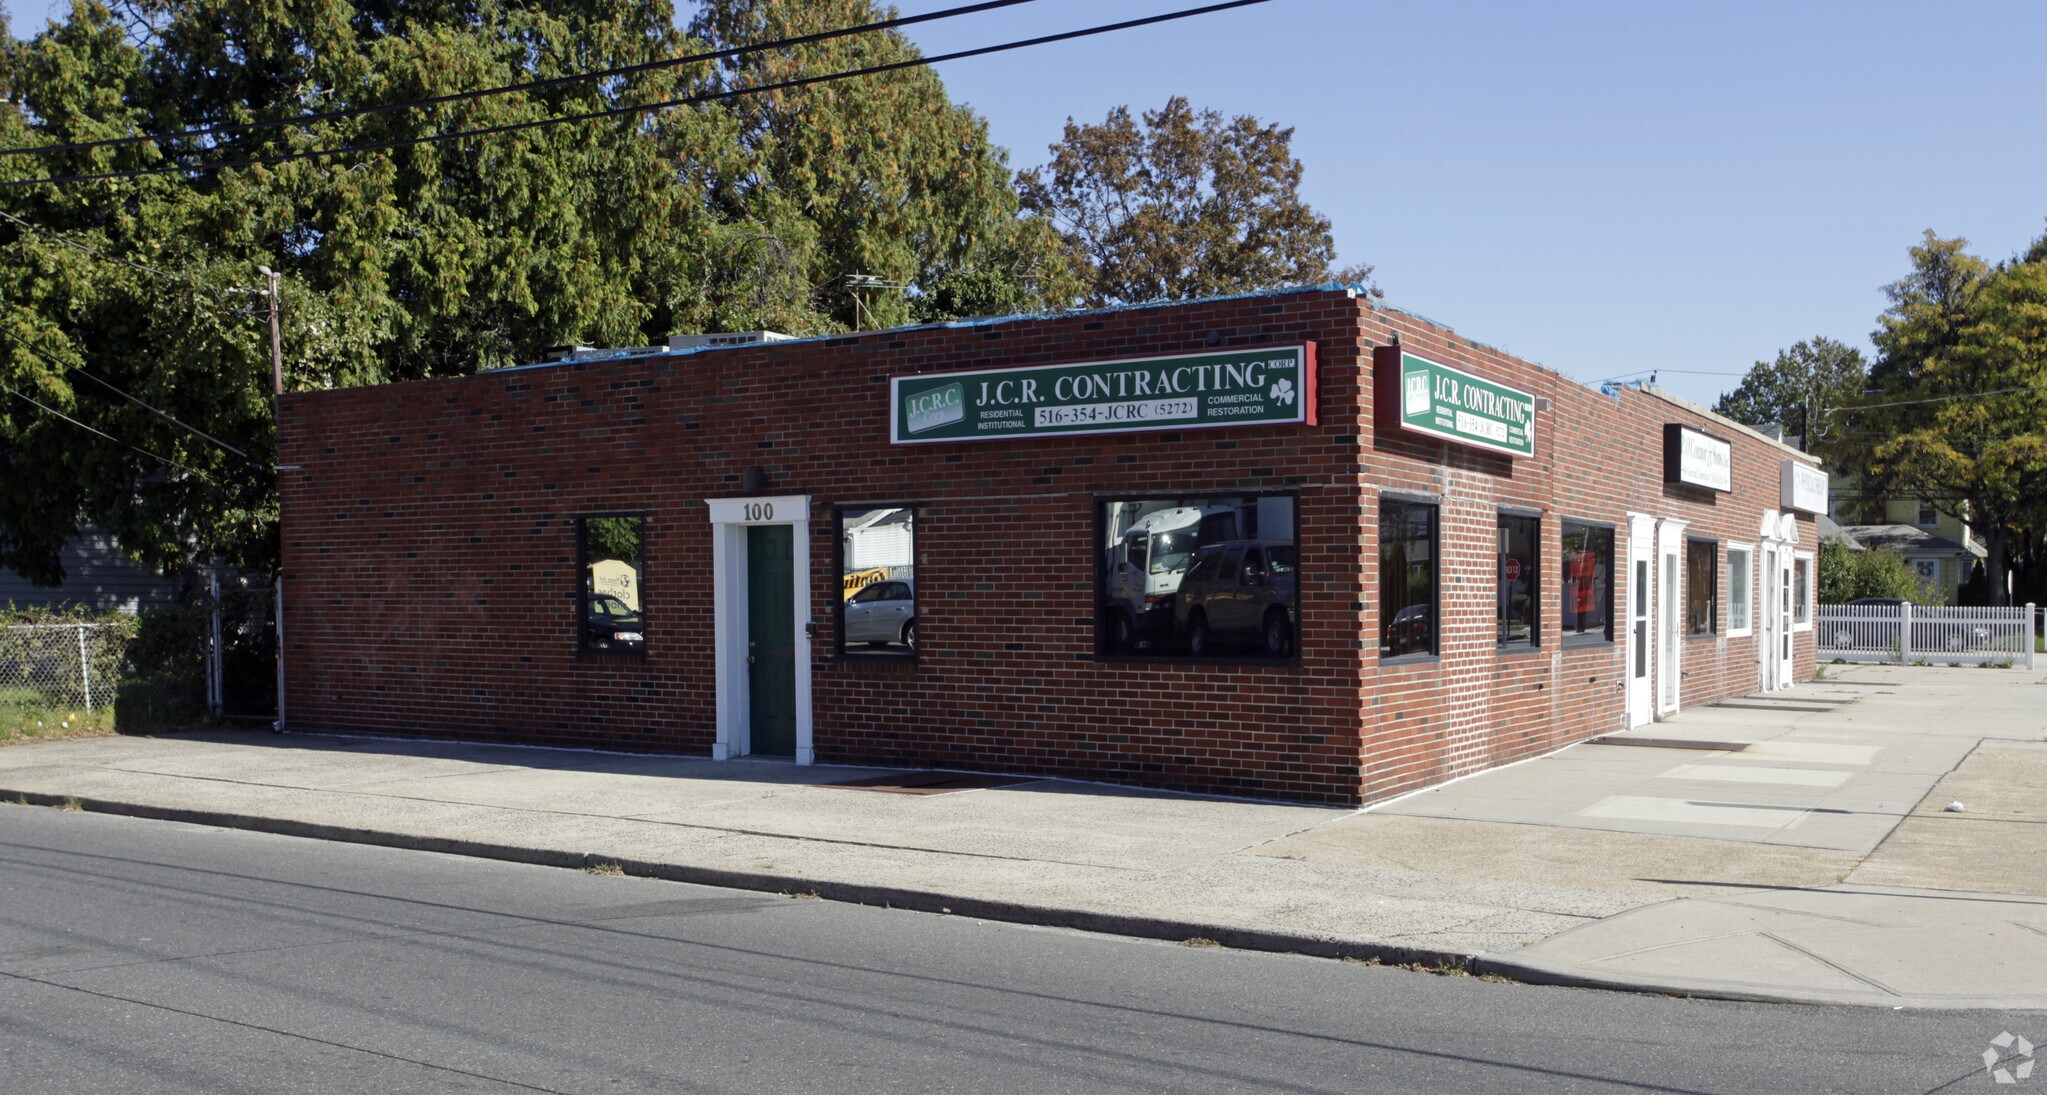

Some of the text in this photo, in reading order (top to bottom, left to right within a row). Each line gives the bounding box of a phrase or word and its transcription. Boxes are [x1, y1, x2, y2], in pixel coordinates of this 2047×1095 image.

[976, 361, 1266, 407] J.C.R. CONTRACTING
[909, 388, 960, 418] J.C.R.C.
[1207, 393, 1264, 405] COMMERCIAL
[1434, 374, 1525, 425] J.C.R. CONTRACTING
[980, 409, 1024, 419] RESIDENTIAL
[1039, 401, 1193, 425] 516-354-JCRC (5272)
[1207, 405, 1264, 416] RESTORATION
[977, 419, 1026, 430] INSTITUTIONAL
[744, 502, 774, 521] 100
